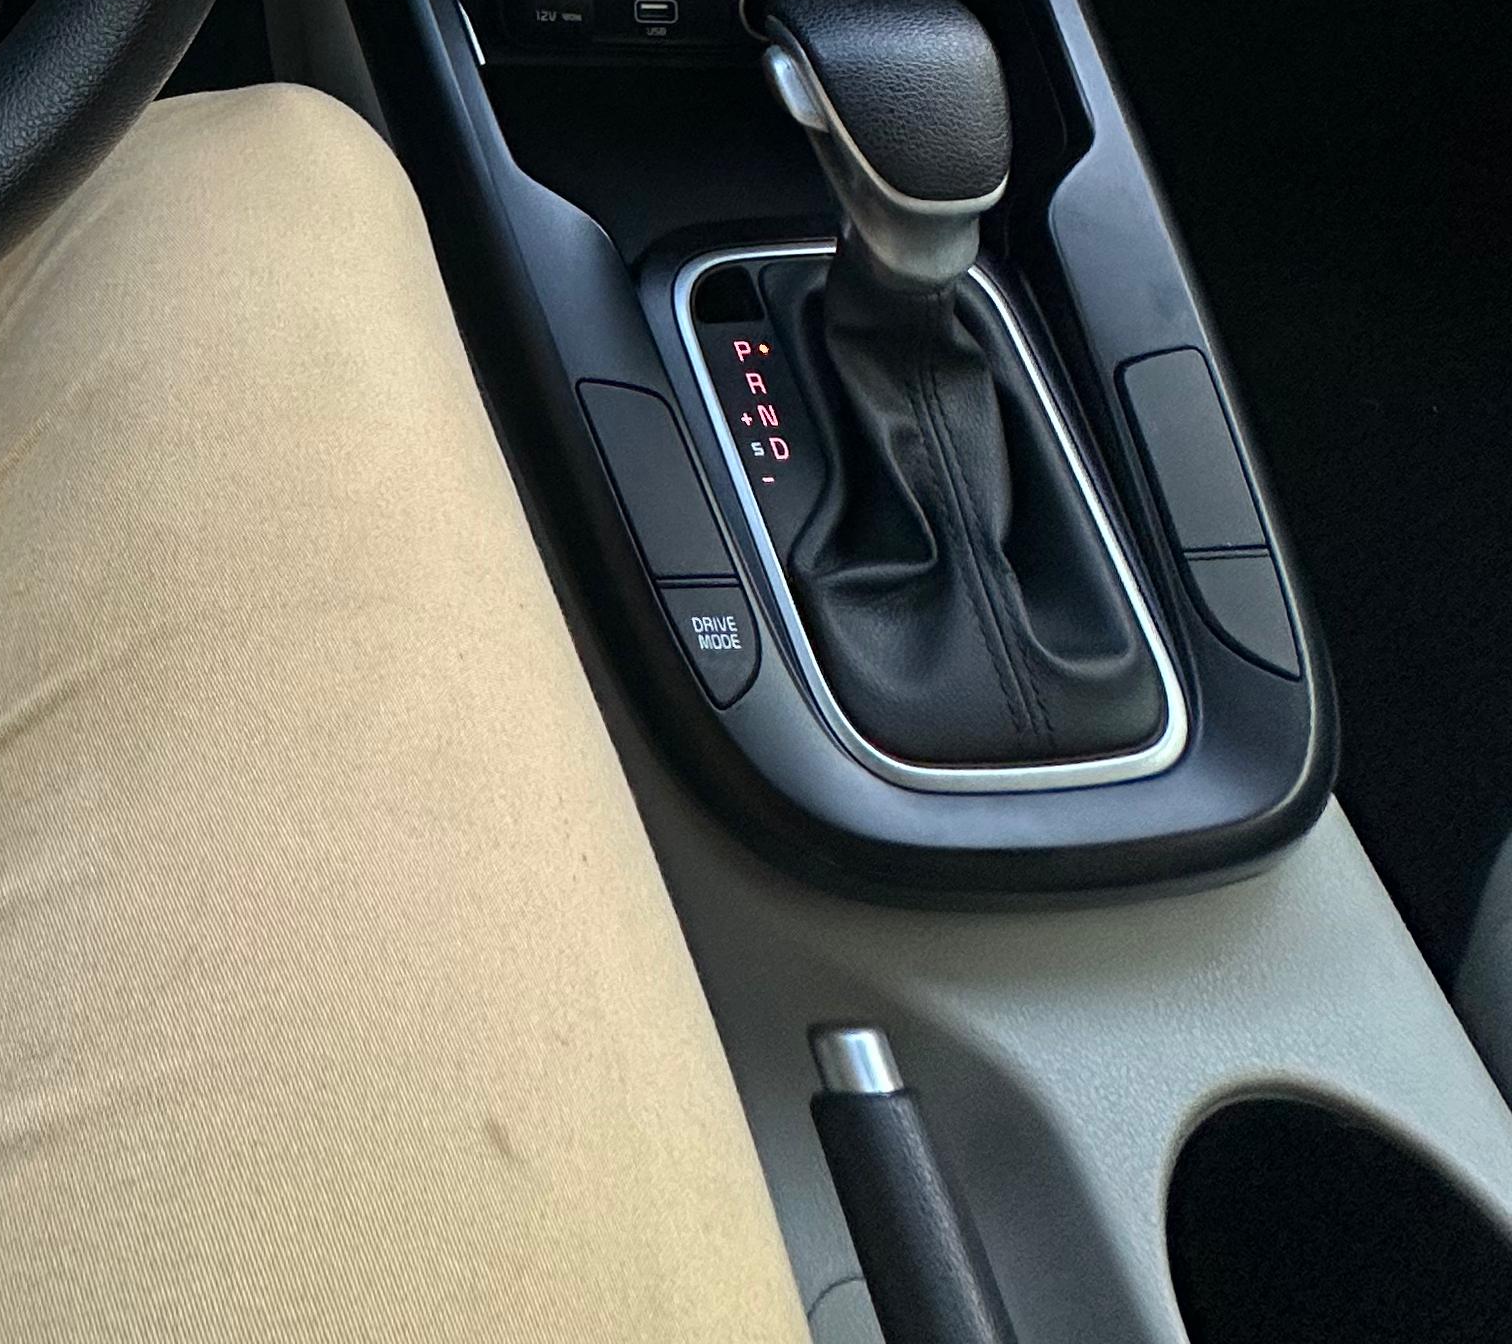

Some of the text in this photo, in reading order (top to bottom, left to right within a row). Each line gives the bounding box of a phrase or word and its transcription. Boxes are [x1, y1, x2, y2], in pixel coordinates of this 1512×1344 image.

[733, 340, 752, 362] P
[745, 372, 767, 395] R
[757, 404, 779, 428] N
[751, 437, 789, 461] S D
[692, 615, 738, 633] DRIVE
[698, 633, 742, 650] MODE
